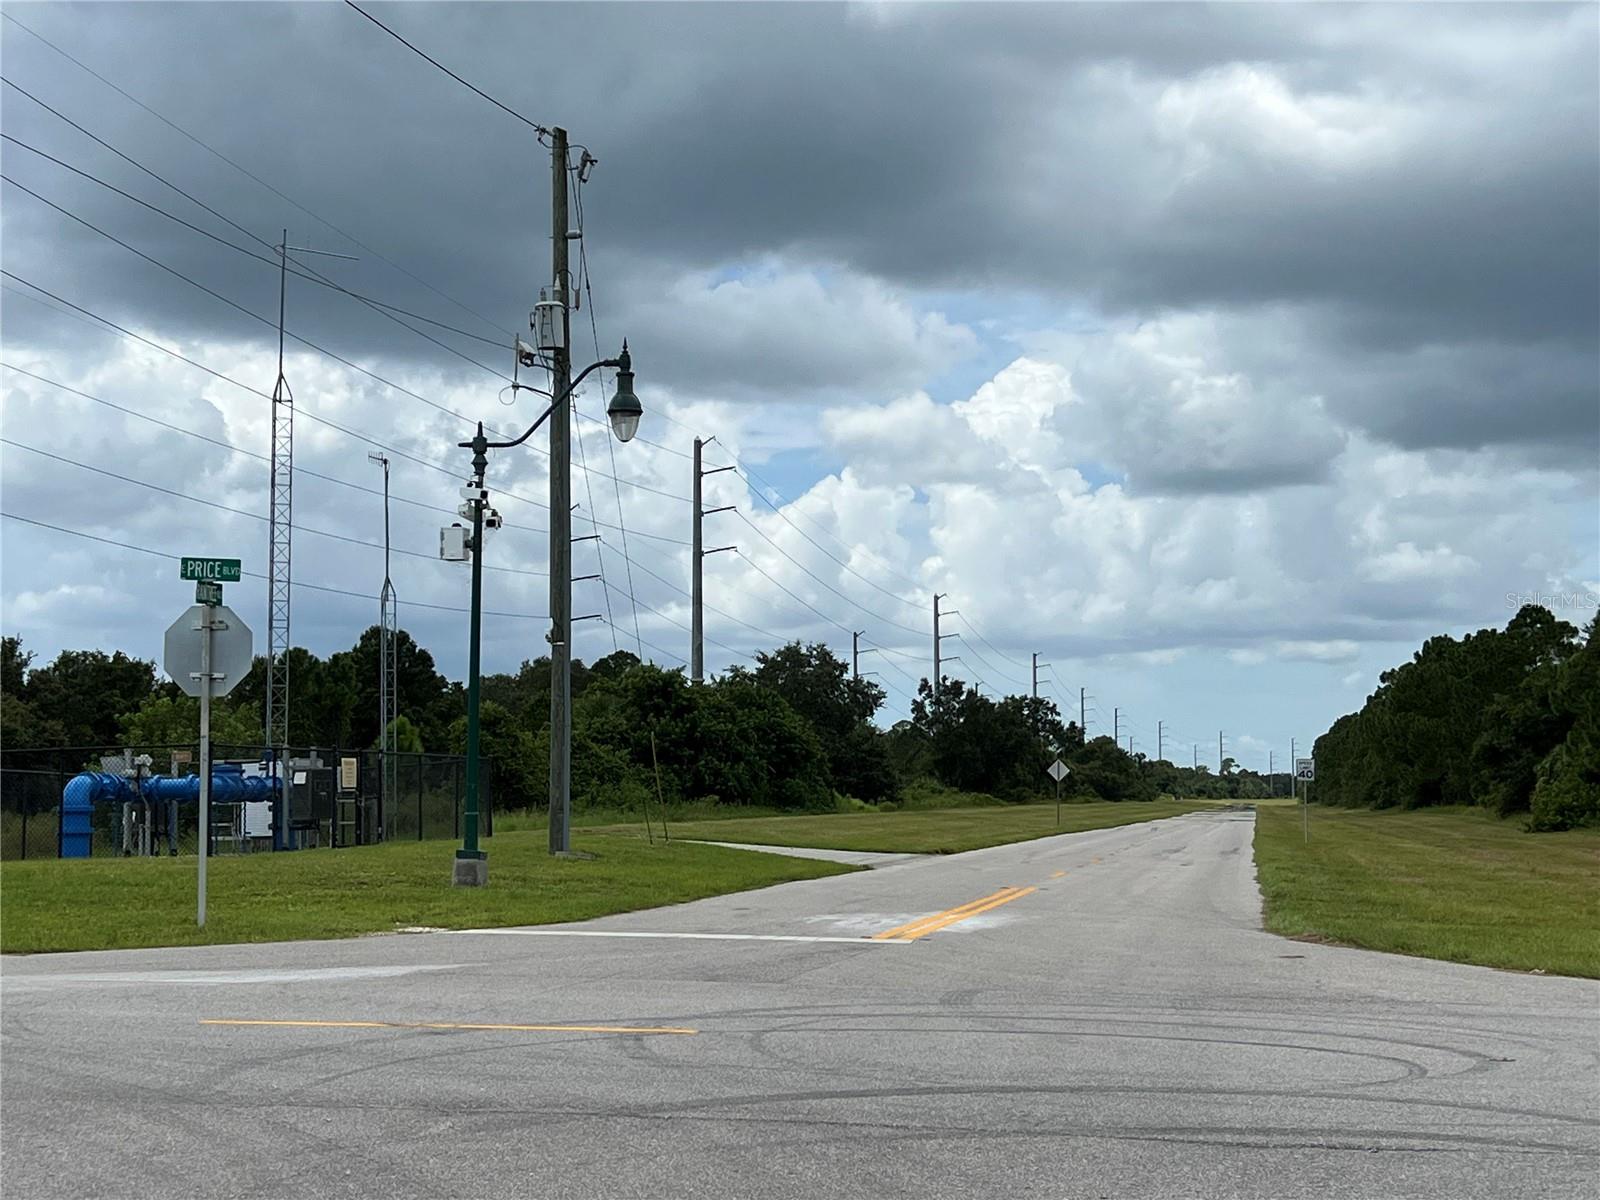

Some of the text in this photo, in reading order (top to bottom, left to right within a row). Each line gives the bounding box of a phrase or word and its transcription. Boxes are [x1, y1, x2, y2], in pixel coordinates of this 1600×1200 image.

[181, 560, 241, 578] E PRICE BLVD
[1298, 770, 1313, 779] 40
